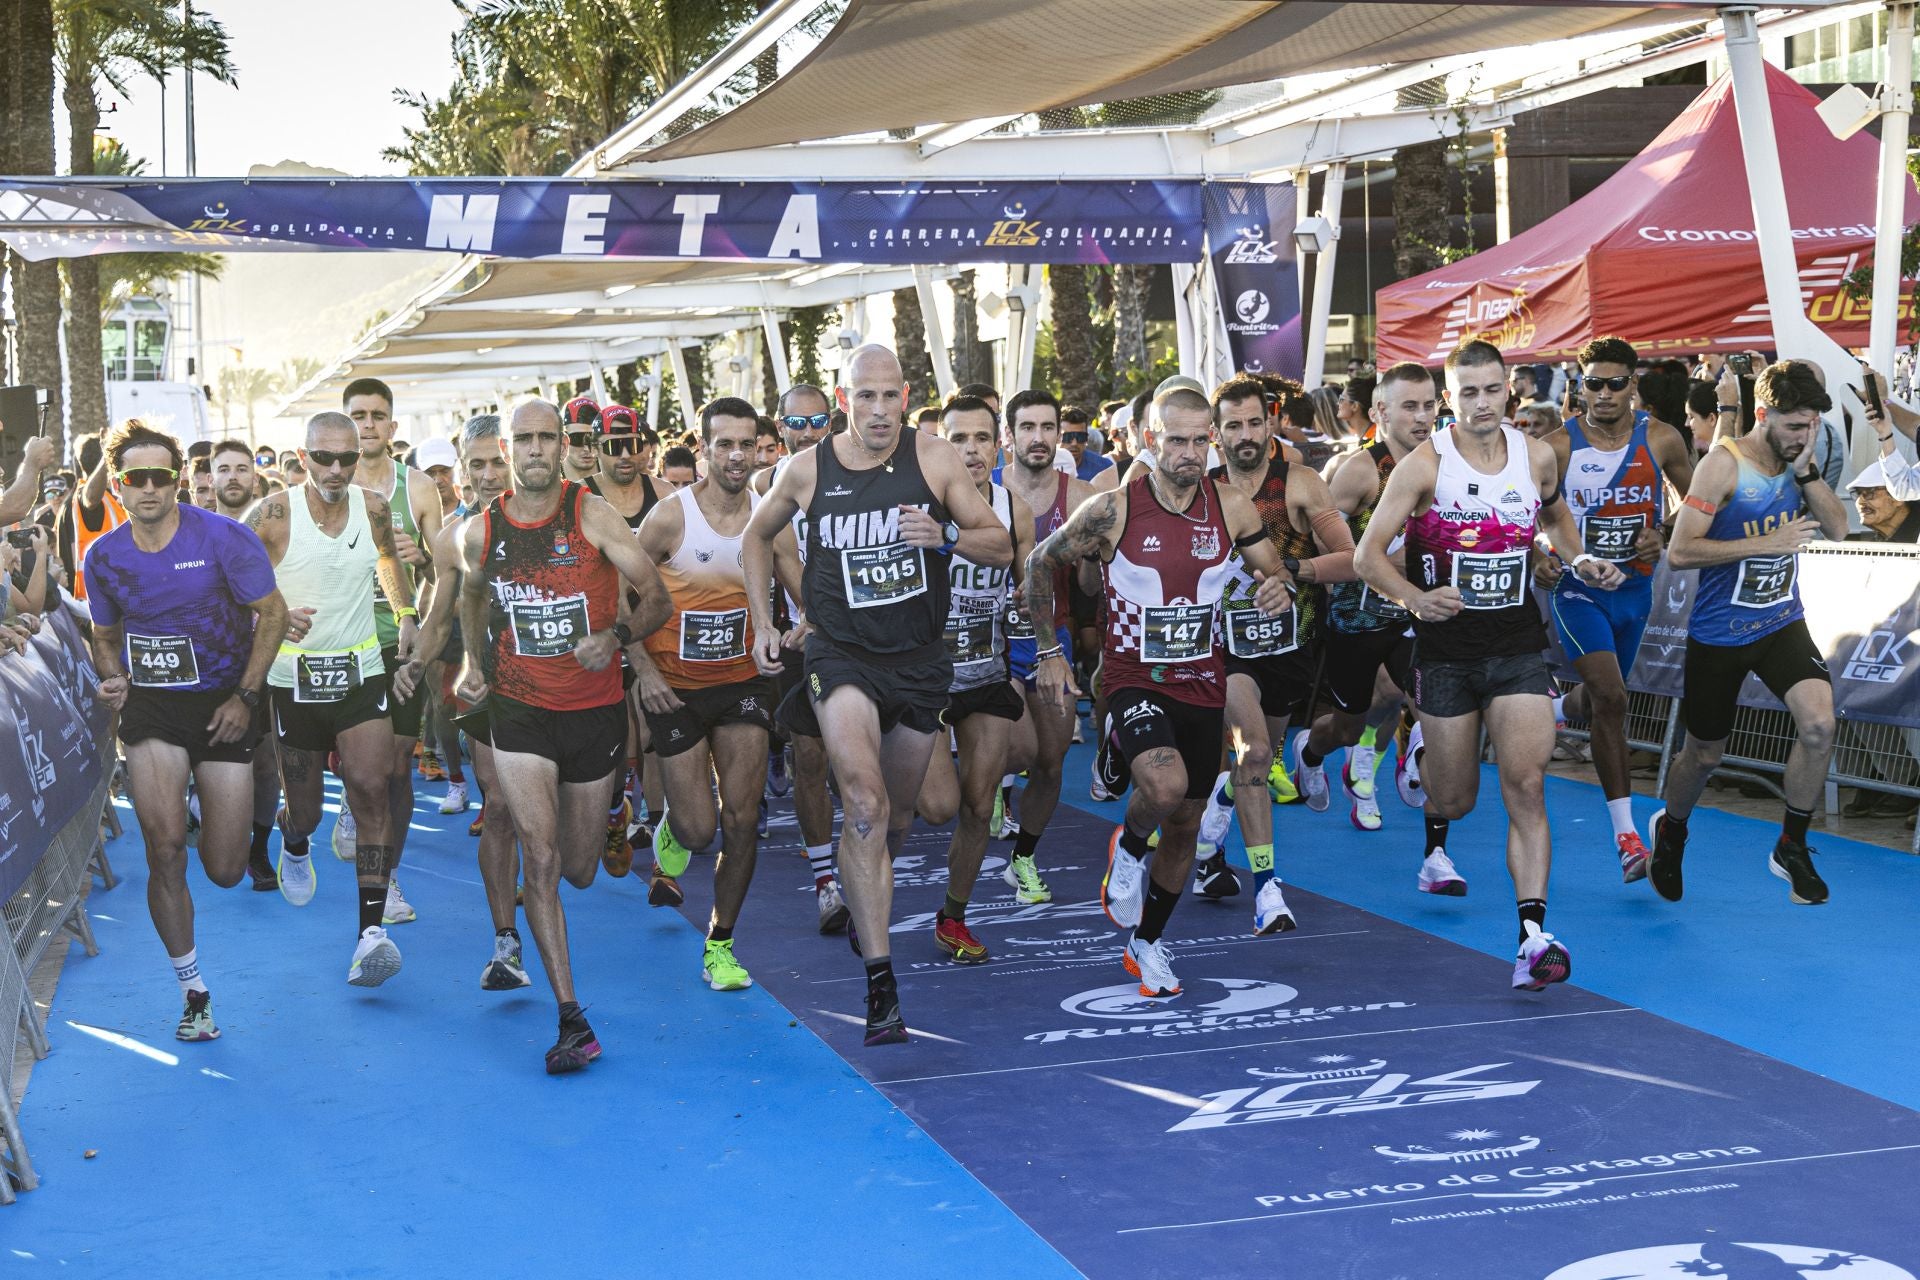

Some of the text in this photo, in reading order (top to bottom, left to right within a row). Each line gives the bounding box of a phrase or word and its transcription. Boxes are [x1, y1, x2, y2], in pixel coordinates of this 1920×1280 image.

[253, 223, 395, 236] SOLIDARIA
[425, 194, 822, 258] META
[868, 220, 1172, 240] CARRERA 10K SOLIDARIA
[833, 240, 930, 248] PUERTO
[1228, 240, 1280, 256] 10K
[1438, 511, 1490, 521] CARTAGENA
[1612, 518, 1622, 527] IX
[1596, 530, 1634, 546] 237
[852, 553, 876, 561] CARRERA
[878, 549, 889, 560] IX
[174, 559, 205, 570] KIPRUN
[857, 558, 916, 585] 1015
[1488, 559, 1499, 568] IX
[1470, 572, 1512, 591] 810
[1757, 571, 1787, 591] 713
[542, 605, 553, 615] IX
[1176, 608, 1187, 617] IX
[714, 615, 725, 624] IX
[958, 617, 967, 626] IX
[528, 618, 574, 639] 196
[697, 626, 734, 645] 226
[1160, 622, 1202, 642] 147
[1245, 620, 1283, 640] 655
[151, 638, 160, 647] IX
[537, 638, 568, 646] ALEJANDRO
[957, 631, 970, 648] 5
[1850, 630, 1911, 665] 10K
[141, 652, 180, 668] 449
[324, 657, 333, 666] IX
[310, 671, 349, 686] 672
[1851, 664, 1897, 681] CPC
[1024, 1000, 1417, 1044] Runtriton
[1152, 1014, 1334, 1037] Cartagena
[1254, 1144, 1762, 1207] Puerto de Cartagena
[1390, 1181, 1741, 1225] Autoridad Portuaria de Cartagena
